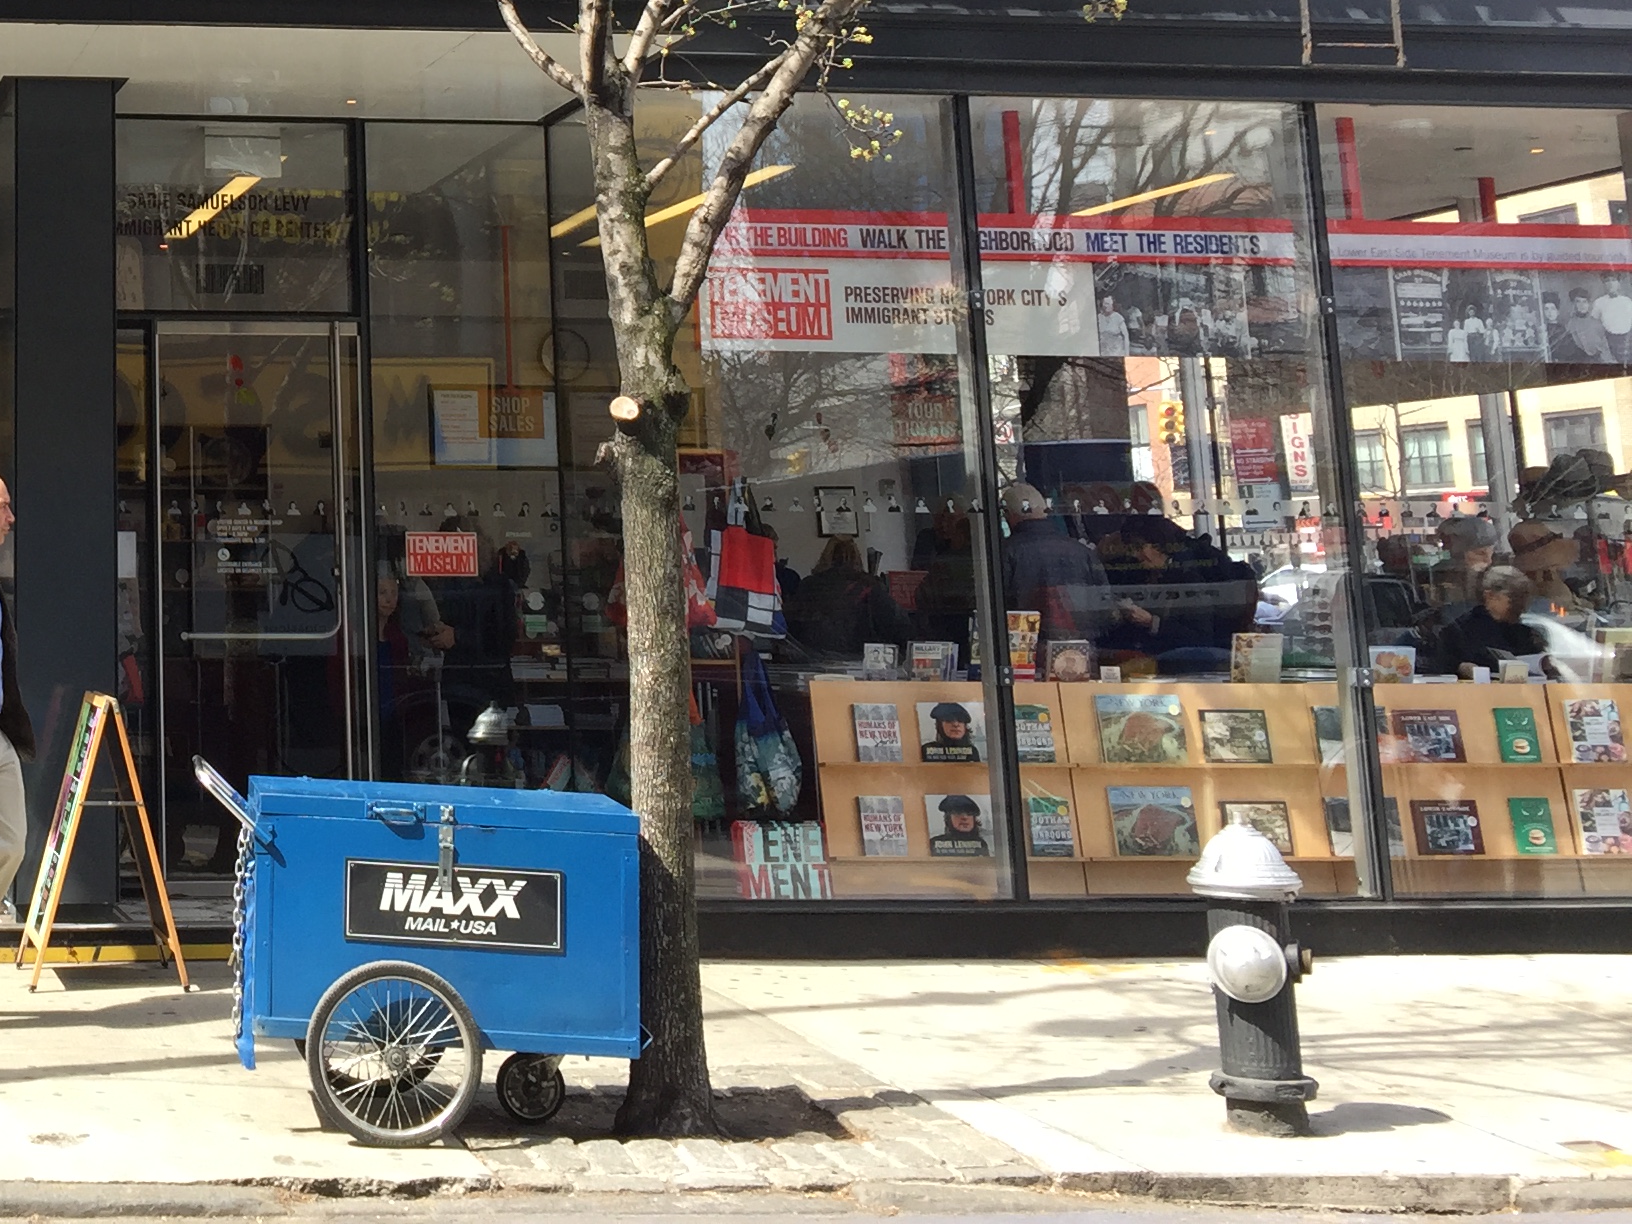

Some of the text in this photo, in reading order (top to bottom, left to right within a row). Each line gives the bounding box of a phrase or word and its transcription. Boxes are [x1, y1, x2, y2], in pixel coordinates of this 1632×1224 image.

[176, 192, 269, 211] SAMUELSON
[274, 193, 311, 211] LEVY
[748, 226, 773, 247] THE
[777, 226, 848, 248] BUILDING
[859, 228, 908, 250] WALK
[915, 229, 946, 250] THE
[1085, 232, 1261, 255] MEET THE RESIDENTS
[709, 271, 830, 304] TENEMENT
[844, 286, 934, 304] PRESERVING
[845, 306, 929, 325] IMMIGRANT
[491, 396, 530, 414] SHOP
[908, 402, 944, 418] TOUR
[489, 415, 535, 432] SALES
[407, 536, 476, 554] TENEMENT
[409, 555, 476, 573] MUSEUM
[1140, 698, 1167, 707] YORK
[857, 721, 896, 729] HUMANS OF
[859, 730, 898, 739] NEW YORK
[1149, 790, 1179, 799] YORK
[863, 814, 902, 822] HUMANS OF
[865, 823, 904, 832] NEW YORK
[954, 840, 982, 849] LENNON
[741, 863, 830, 900] MENT
[379, 872, 528, 919] MAXX
